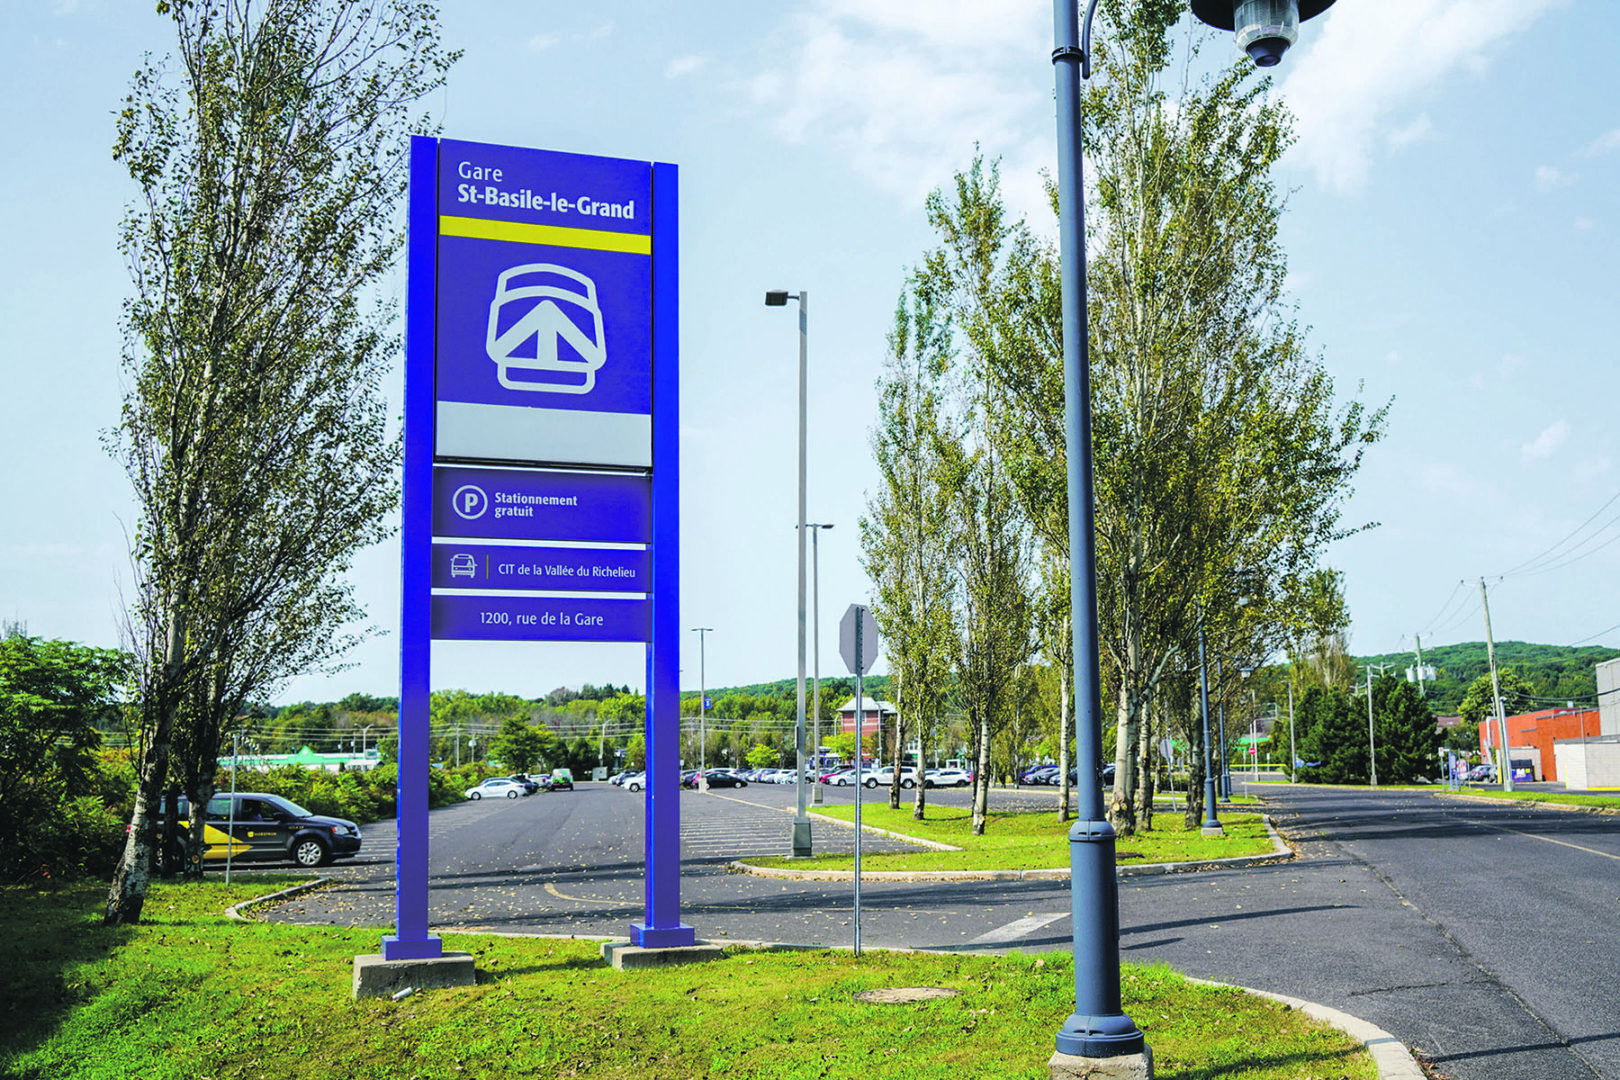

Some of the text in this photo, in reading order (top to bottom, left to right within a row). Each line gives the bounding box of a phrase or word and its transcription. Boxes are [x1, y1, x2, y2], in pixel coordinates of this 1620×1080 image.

[458, 161, 503, 182] Gare
[457, 184, 635, 220] St-Basile-le-Grand
[465, 493, 478, 513] P
[495, 492, 577, 506] Stationnement
[494, 505, 533, 519] gratuit
[498, 563, 636, 578] CIT de la Vallée du Richelieu
[481, 612, 604, 626] 1200, rue de la Gare
